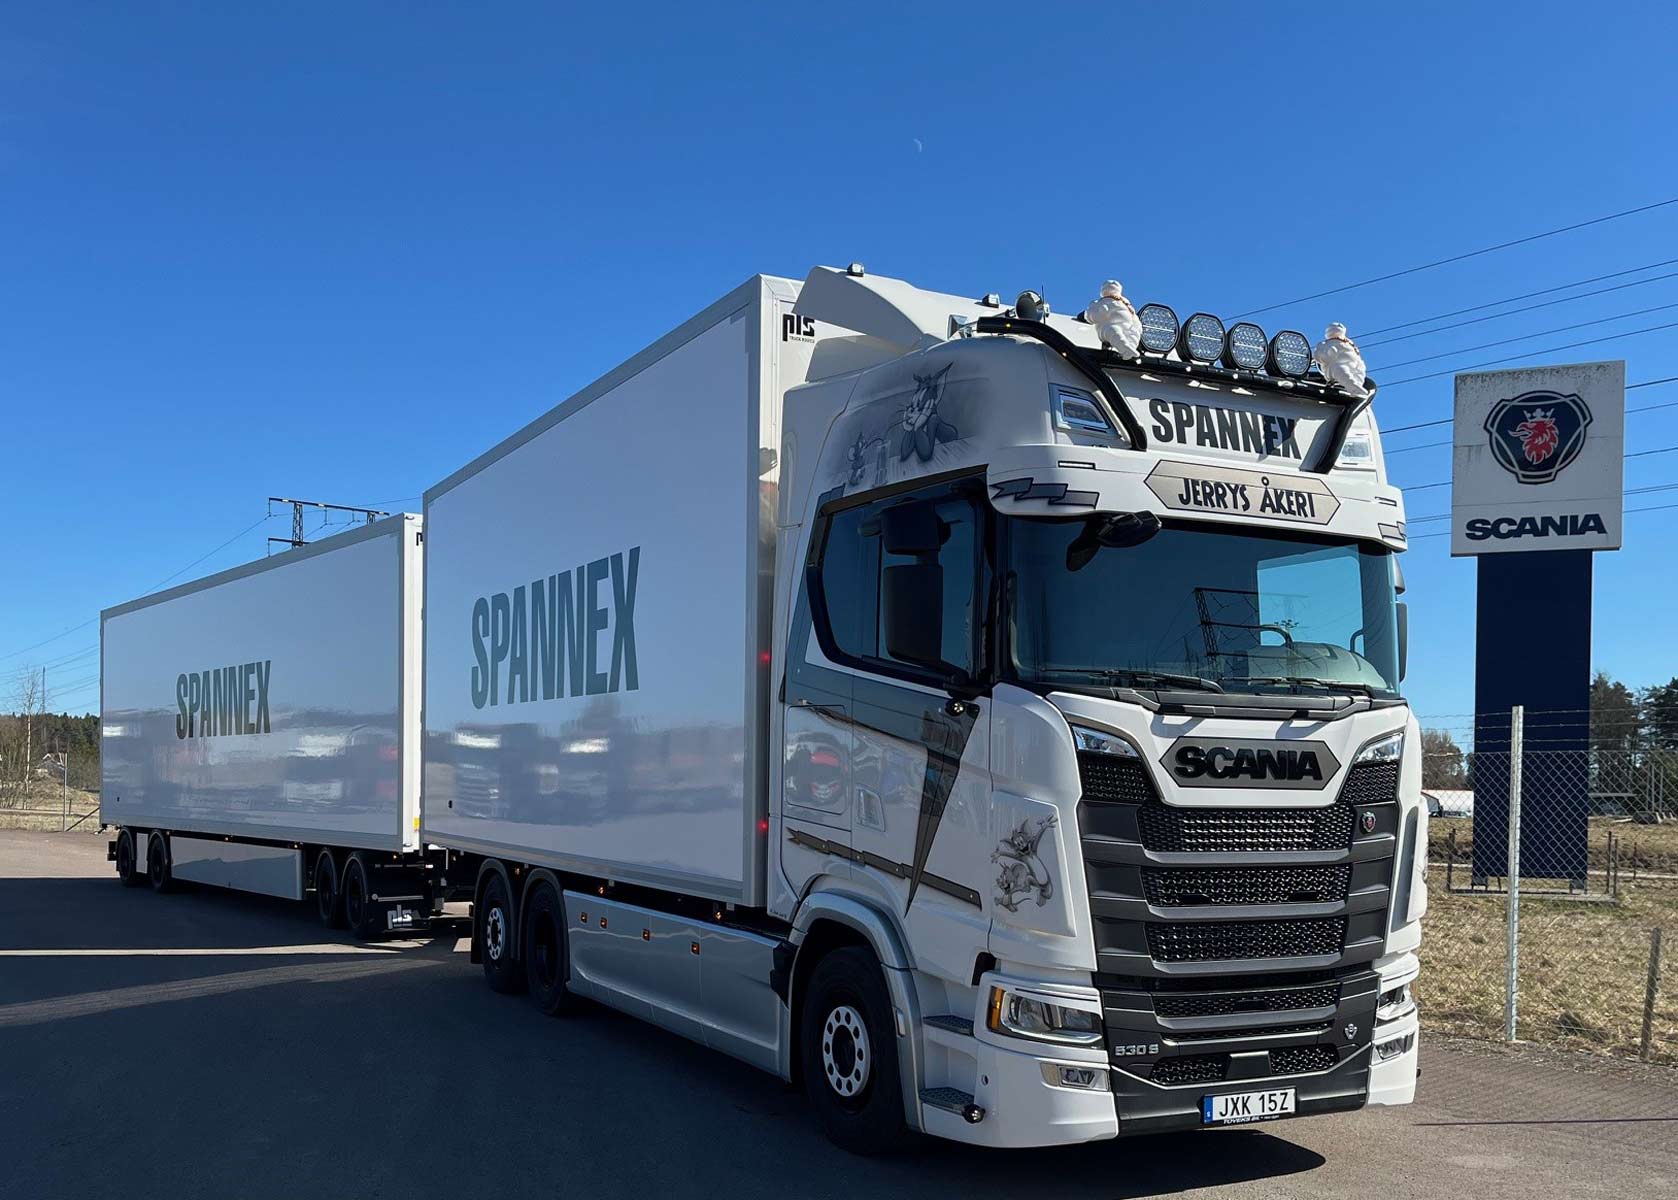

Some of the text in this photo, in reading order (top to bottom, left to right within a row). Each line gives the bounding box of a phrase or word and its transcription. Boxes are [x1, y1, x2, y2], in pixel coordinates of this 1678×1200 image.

[1149, 398, 1302, 460] SPANNEX
[1178, 476, 1316, 518] JERRYS ÅKERI
[1465, 513, 1608, 541] SCANIA
[471, 546, 641, 710] SPANNEX
[176, 660, 271, 740] SPANNEX
[1173, 745, 1324, 781] SCANIA
[1115, 1043, 1160, 1056] 530 S
[1219, 1091, 1289, 1117] JXK 15Z
